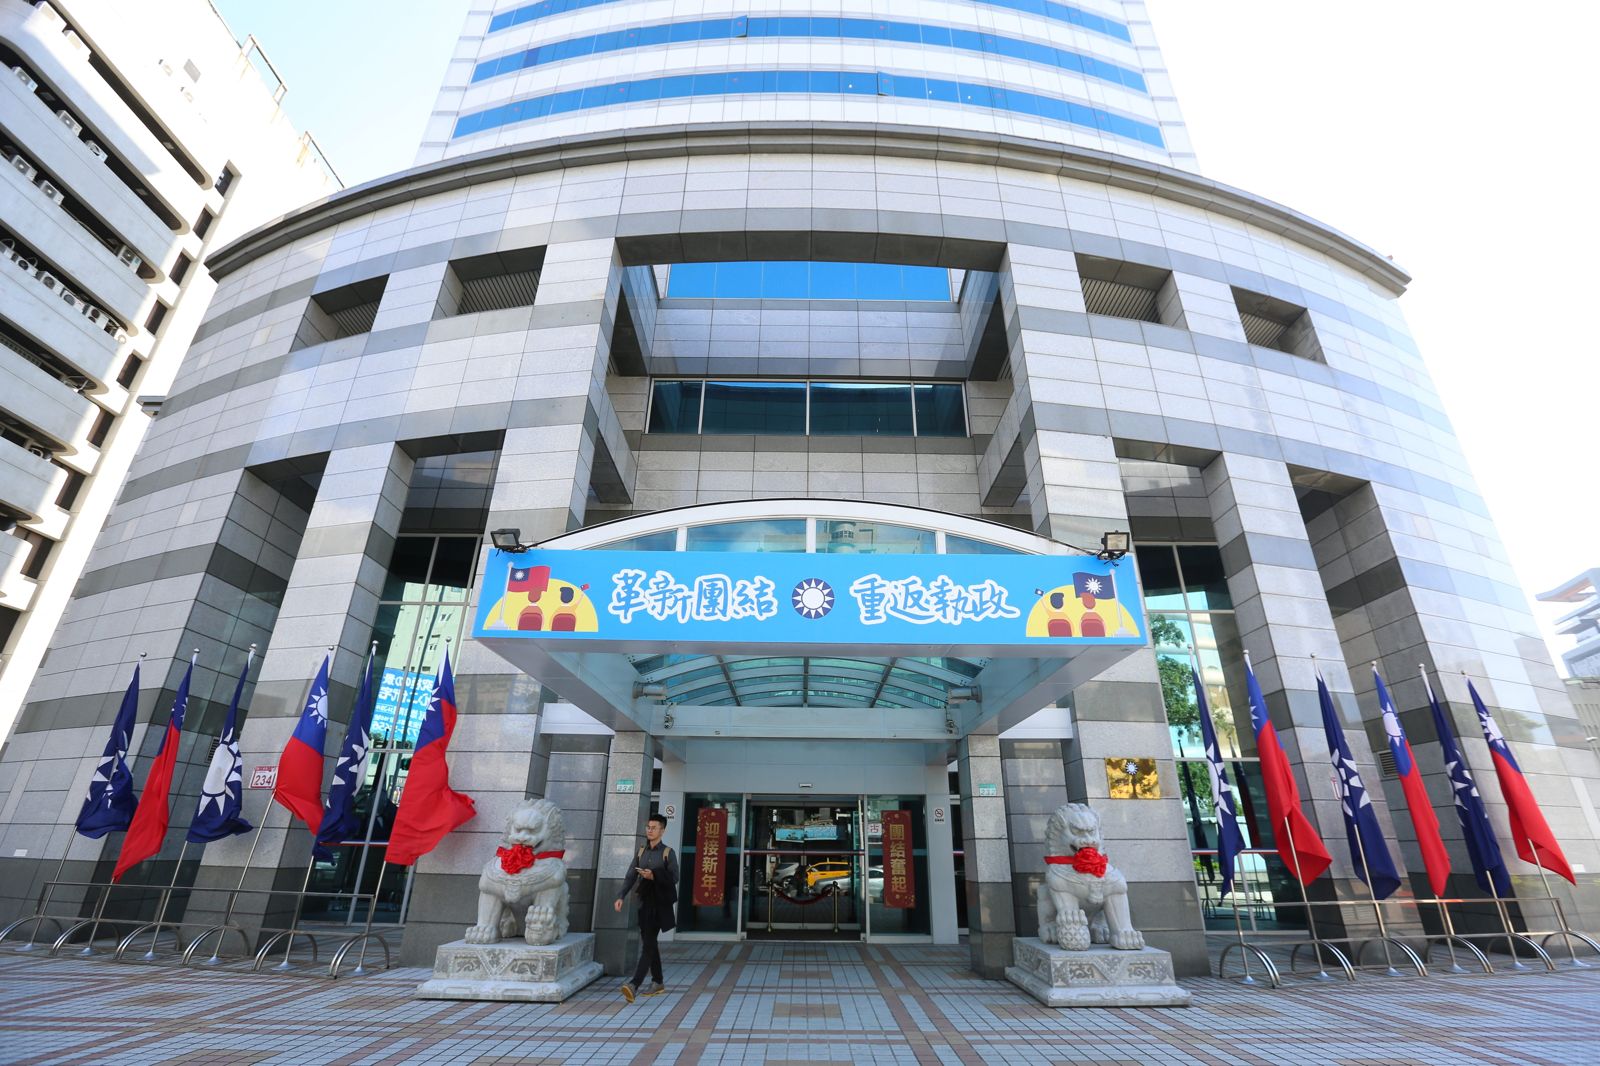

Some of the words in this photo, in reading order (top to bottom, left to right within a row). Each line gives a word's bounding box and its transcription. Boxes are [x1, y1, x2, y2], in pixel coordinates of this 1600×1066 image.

[608, 569, 778, 624] 革新團結
[849, 574, 1021, 625] 重返執政
[255, 775, 272, 786] 234
[701, 822, 720, 891] 迎接新年
[890, 824, 907, 893] 團結奮起
